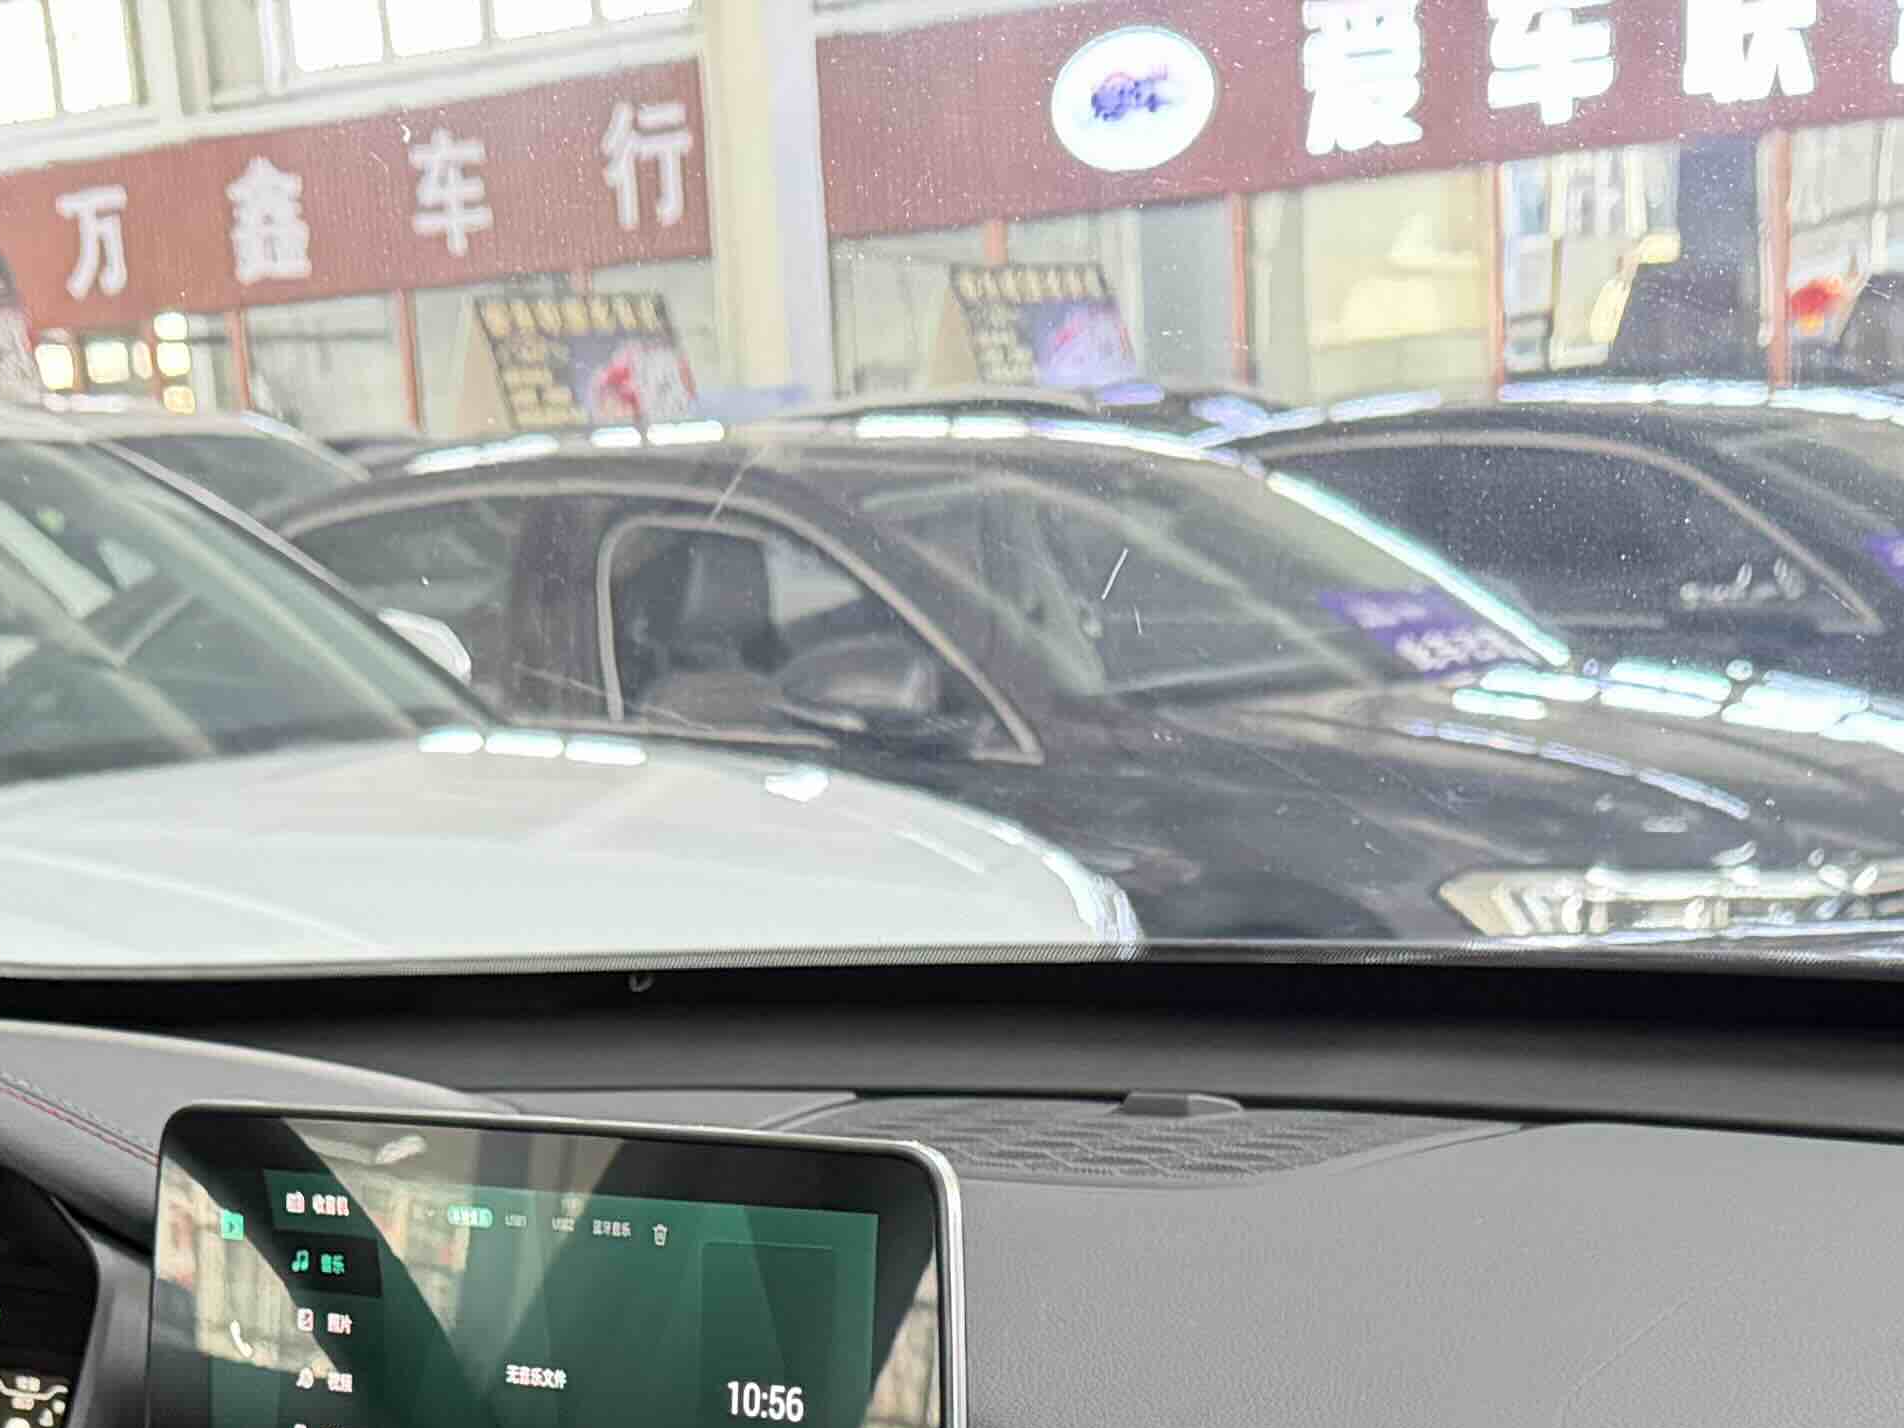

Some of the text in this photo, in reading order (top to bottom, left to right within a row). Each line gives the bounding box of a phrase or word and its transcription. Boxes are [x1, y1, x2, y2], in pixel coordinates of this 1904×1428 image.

[54, 101, 695, 300] 万鑫车行
[311, 1193, 350, 1216] 收音机
[320, 1253, 345, 1275] 音乐
[327, 1312, 353, 1335] 照片
[505, 1364, 567, 1389] 无音乐文件
[727, 1380, 804, 1422] 10:56
